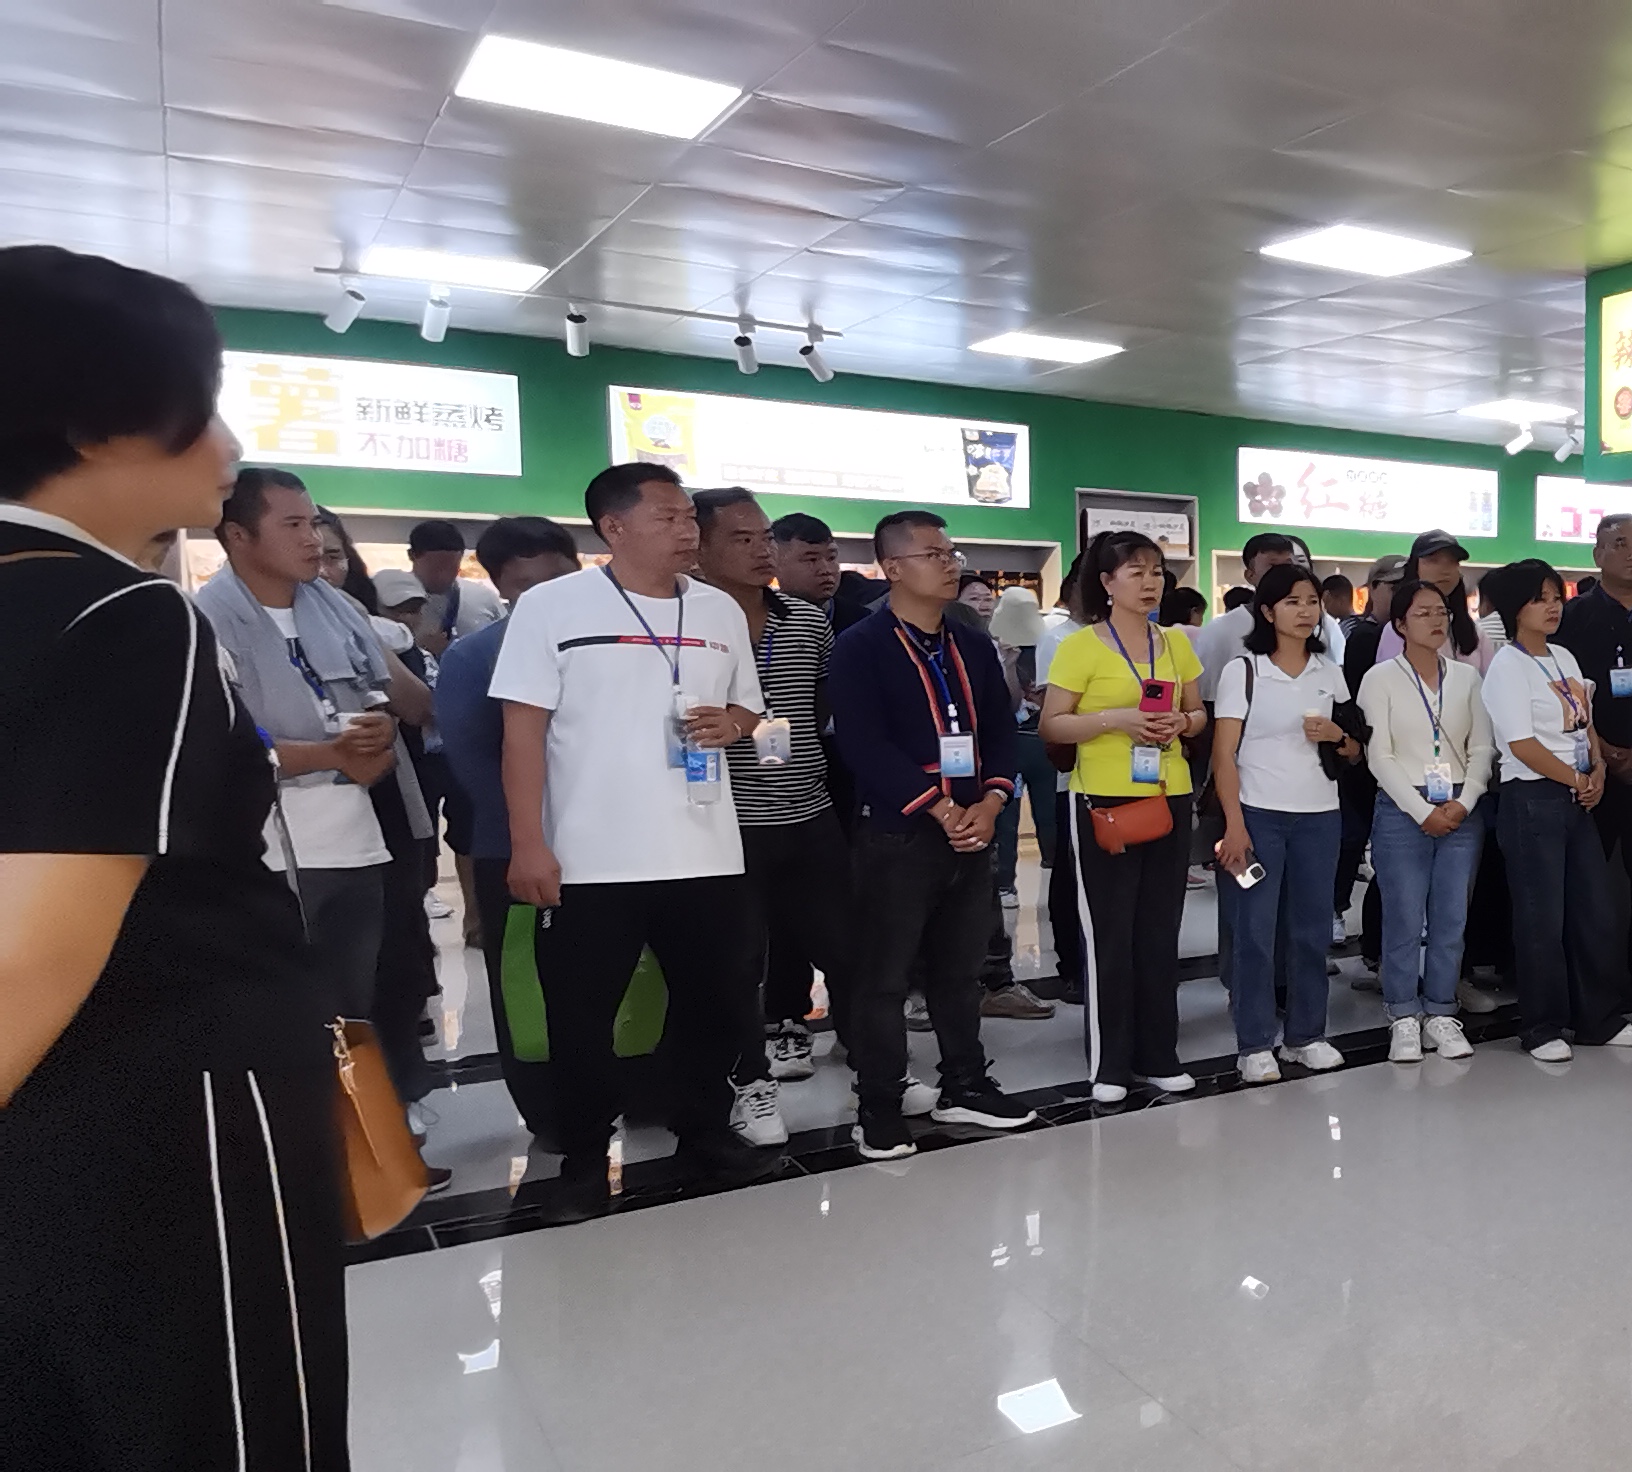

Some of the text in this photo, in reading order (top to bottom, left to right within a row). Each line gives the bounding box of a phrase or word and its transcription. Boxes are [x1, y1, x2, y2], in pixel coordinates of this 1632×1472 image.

[244, 362, 344, 457] 薯
[354, 396, 505, 432] 新鲜蒸烤
[356, 432, 470, 464] 不加糖
